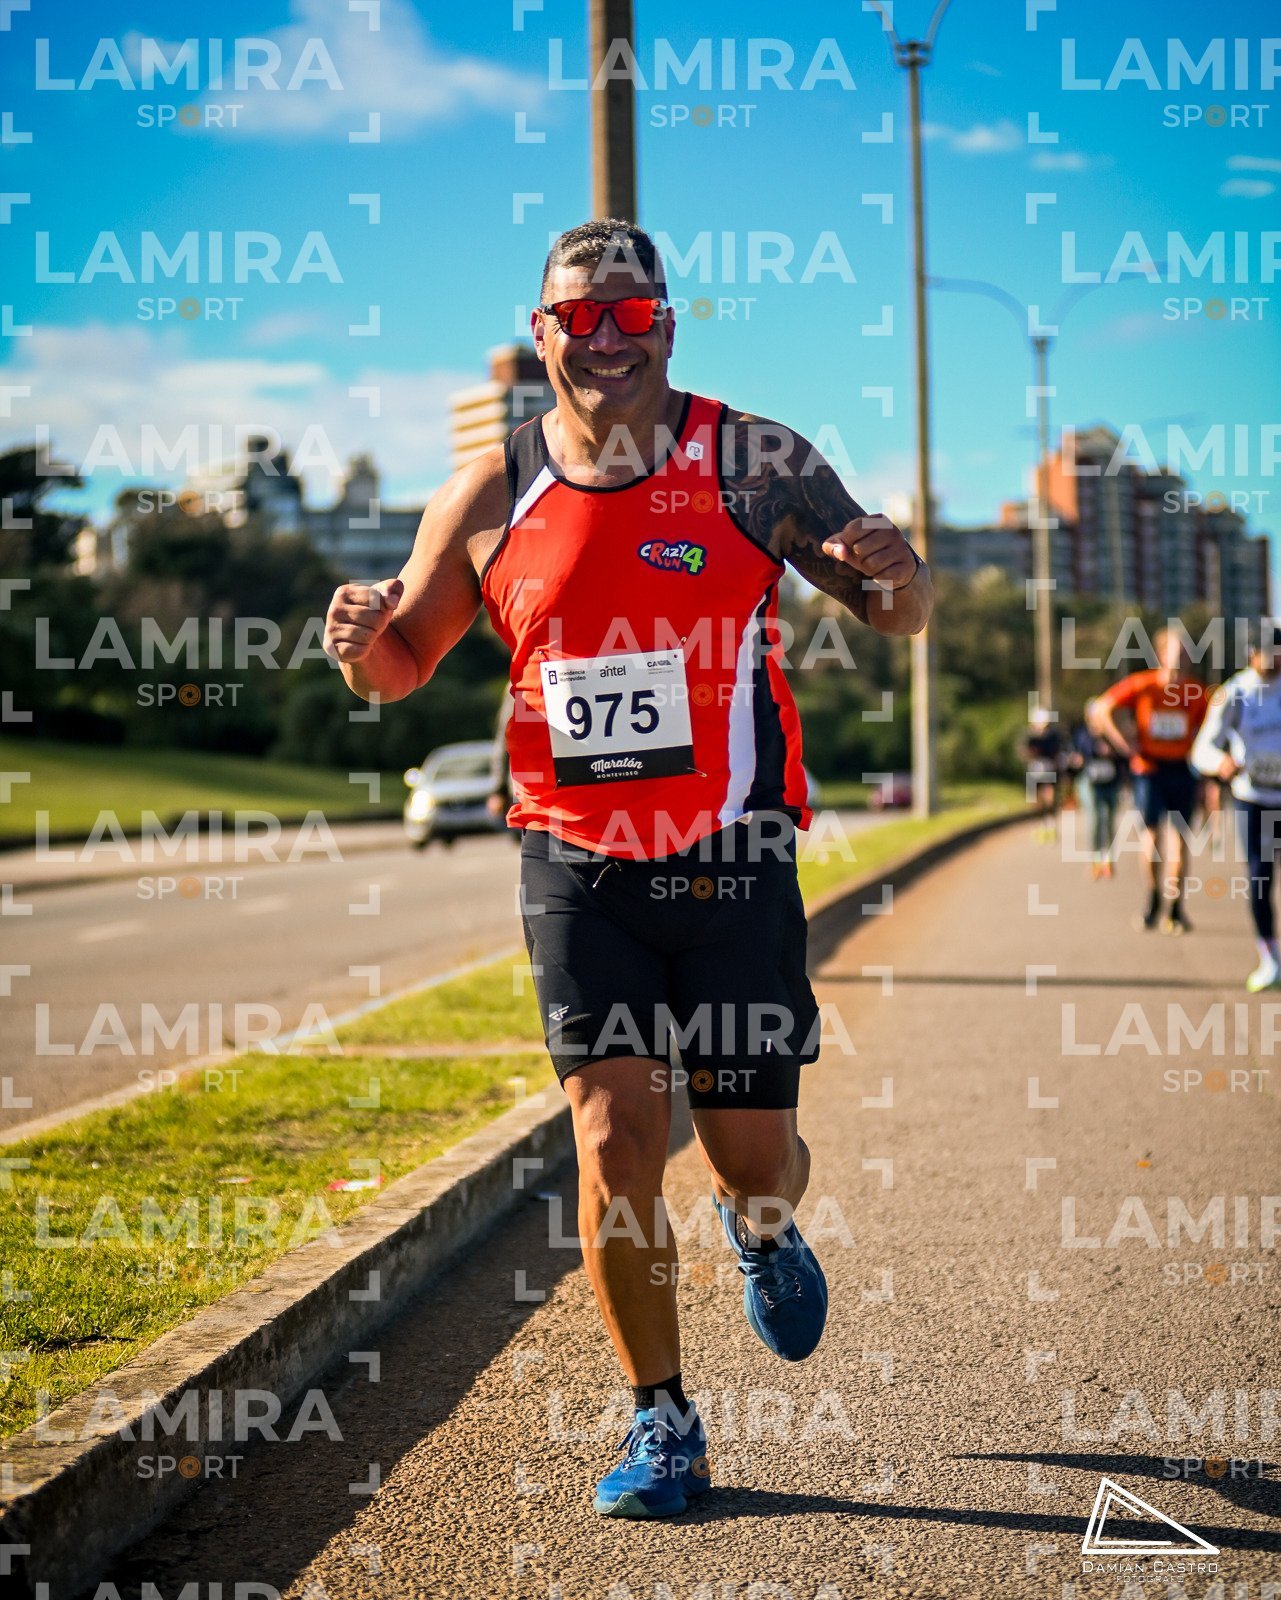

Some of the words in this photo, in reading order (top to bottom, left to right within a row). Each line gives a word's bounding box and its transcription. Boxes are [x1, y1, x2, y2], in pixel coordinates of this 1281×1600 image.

[640, 543, 688, 560] CRAZY
[682, 547, 703, 573] 4
[600, 665, 626, 678] antel
[566, 689, 660, 741] 975
[591, 757, 643, 773] Maratón
[596, 770, 639, 779] MONTEVIDEO
